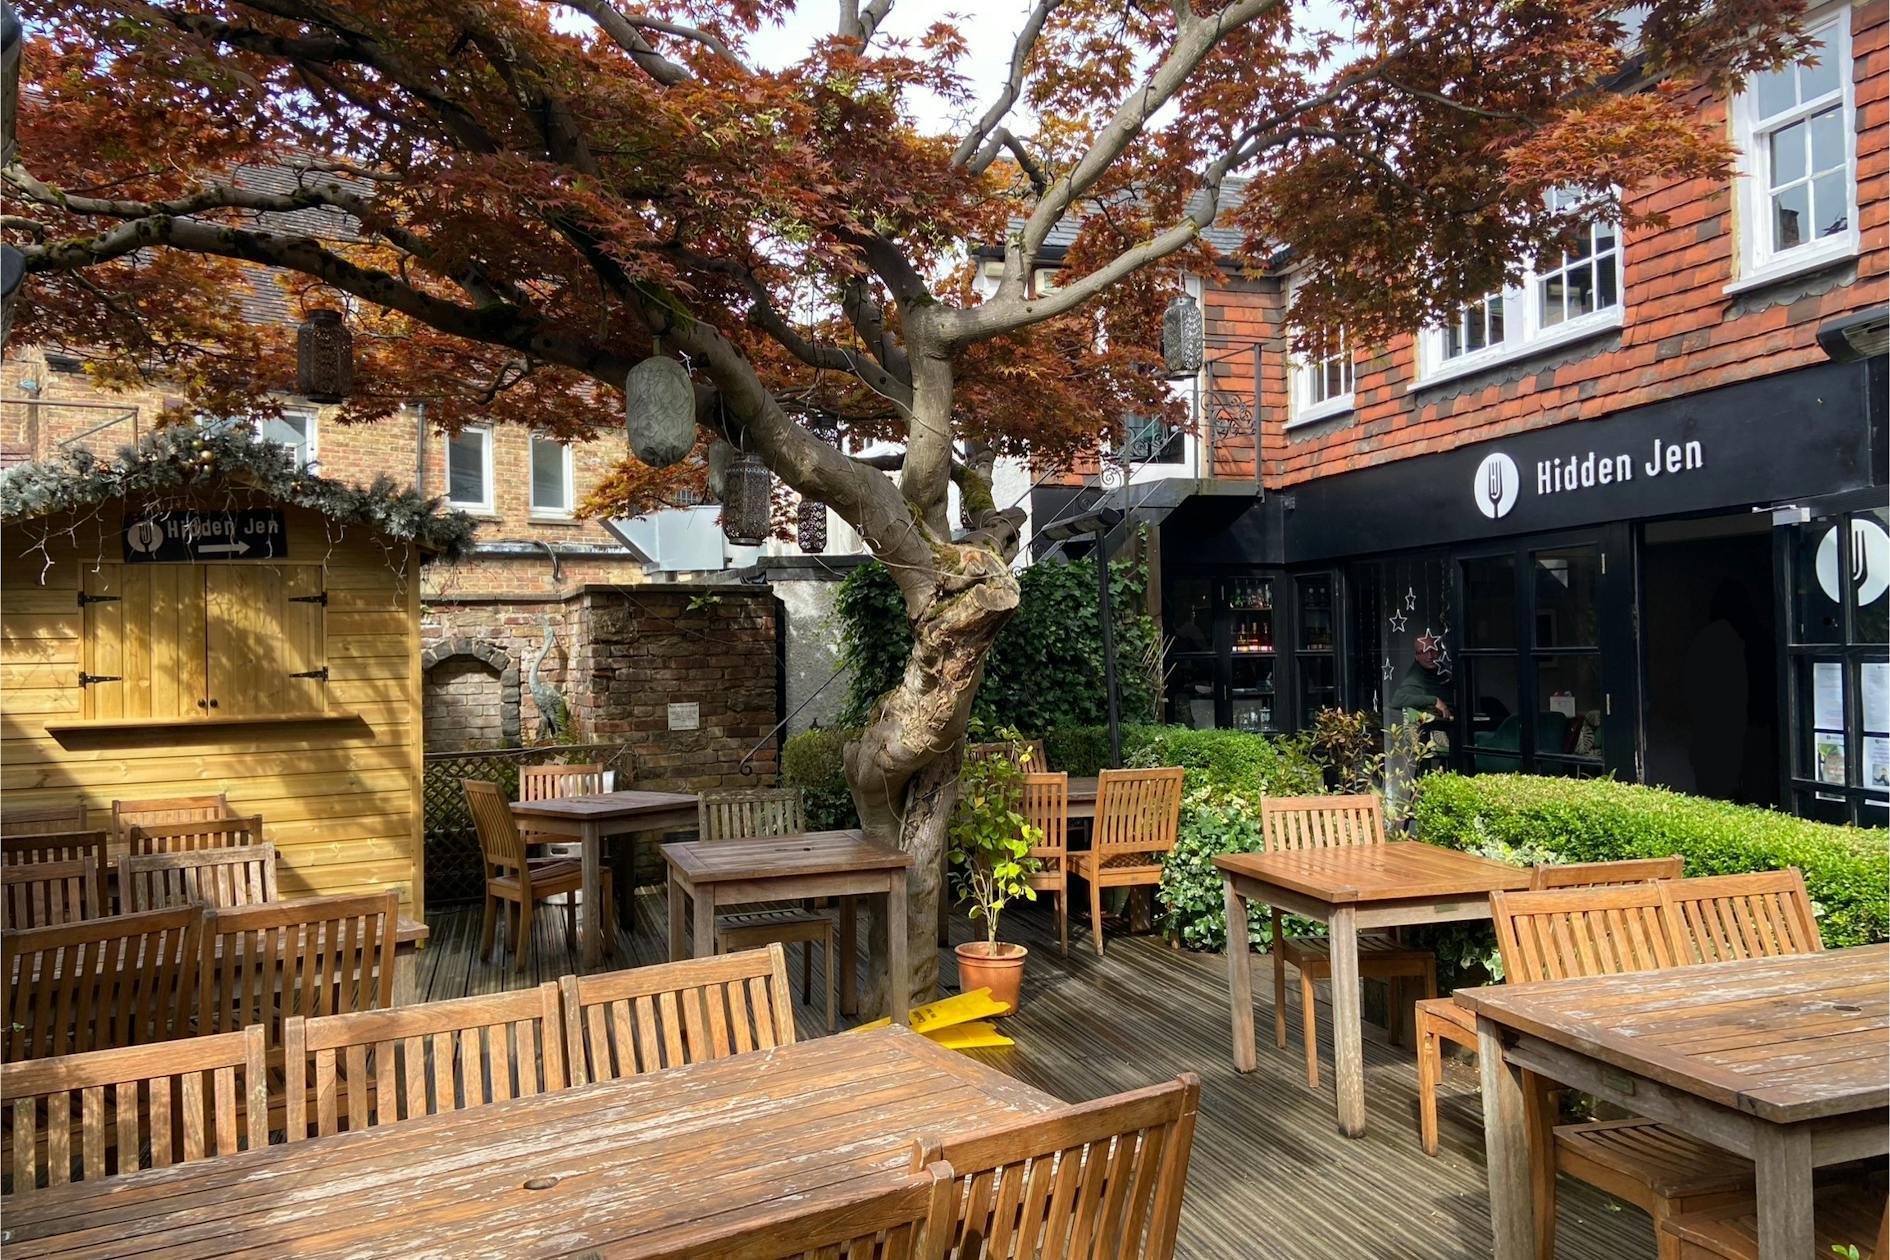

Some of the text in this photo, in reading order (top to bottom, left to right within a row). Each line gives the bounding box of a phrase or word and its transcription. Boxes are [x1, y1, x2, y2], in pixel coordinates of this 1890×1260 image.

[1537, 439, 1703, 495] Hidden Jen
[244, 518, 279, 534] Jen
